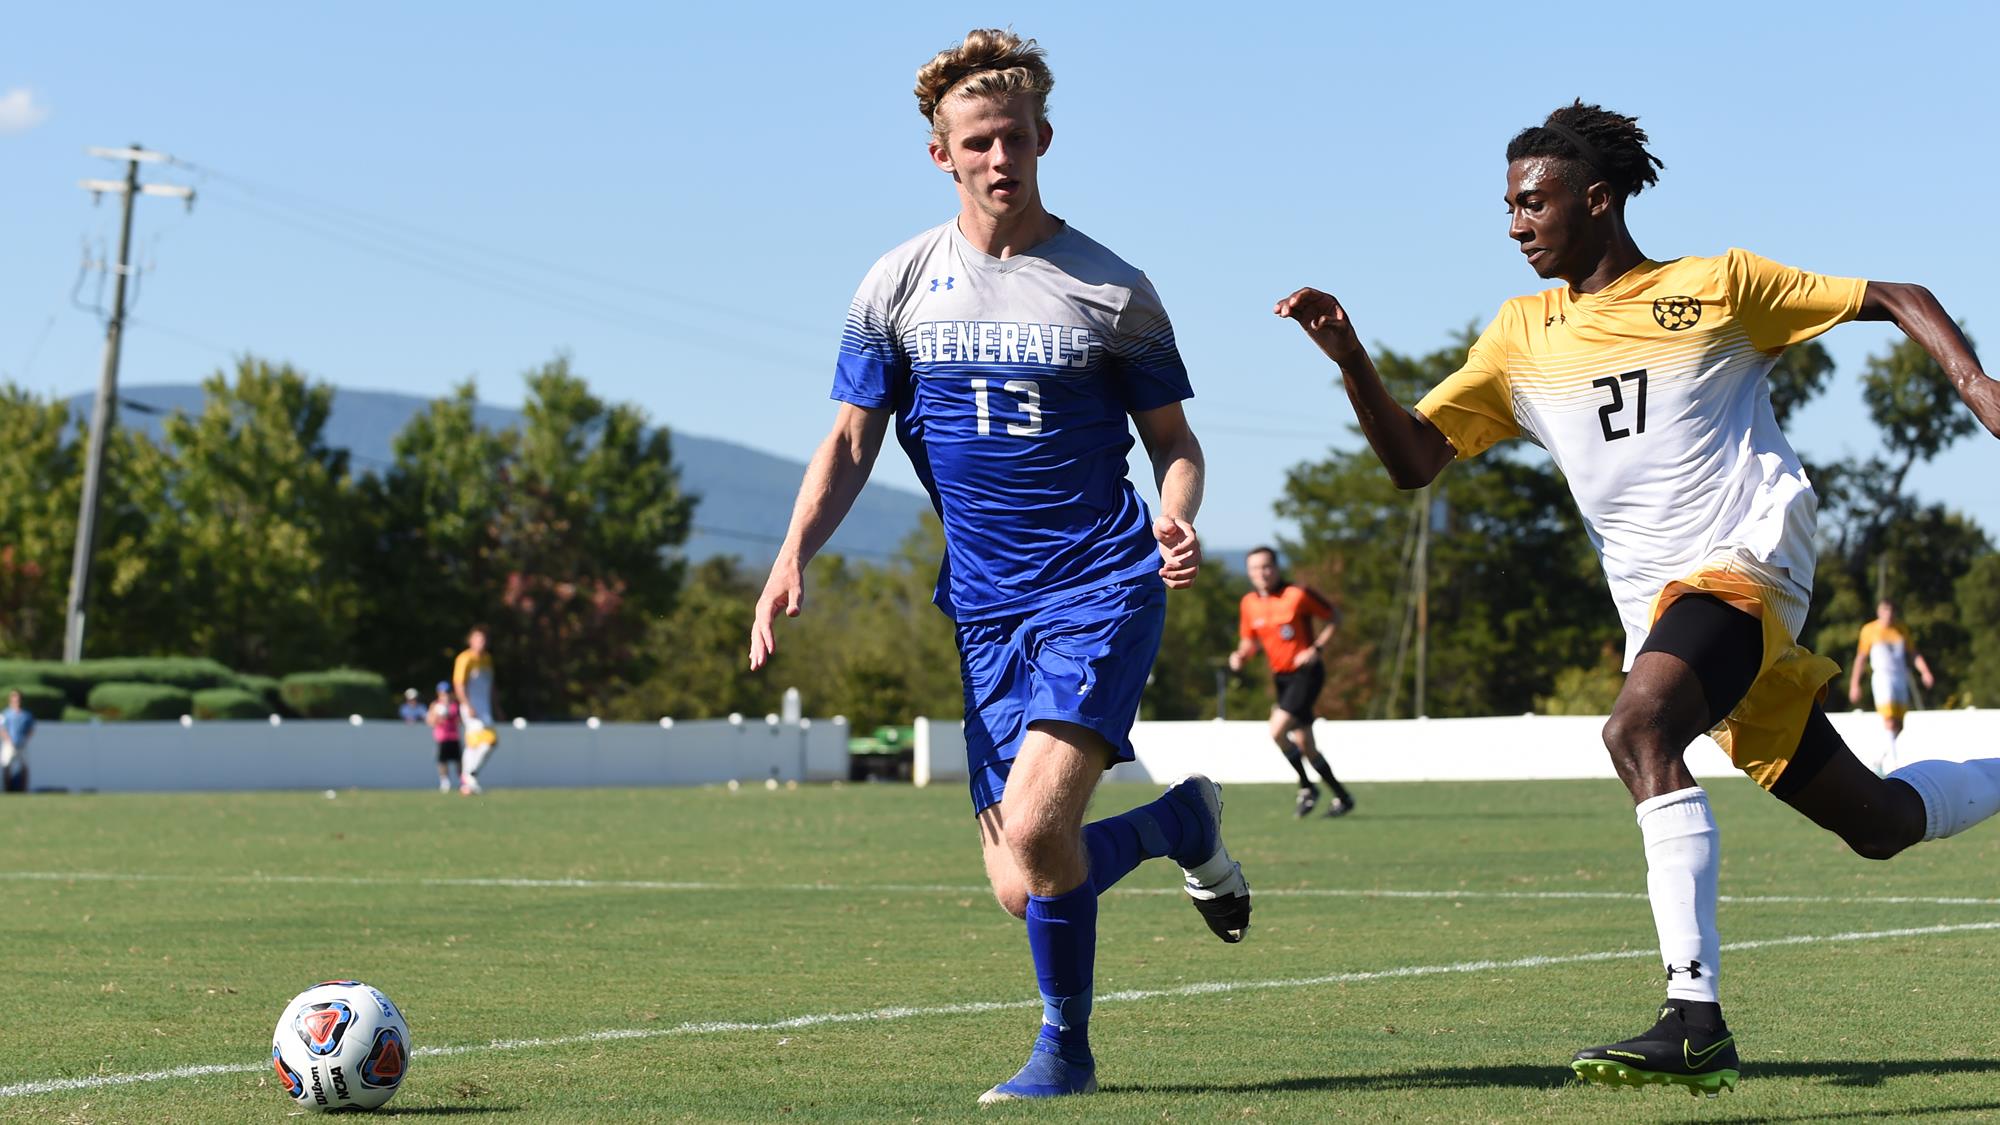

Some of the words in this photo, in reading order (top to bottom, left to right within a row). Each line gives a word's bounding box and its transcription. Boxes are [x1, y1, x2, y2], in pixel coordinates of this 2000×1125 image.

[915, 321, 1090, 368] GENERALS
[971, 379, 1042, 436] 13
[1592, 369, 1648, 442] 27
[311, 1066, 328, 1105] Wilson
[330, 1066, 350, 1099] NCAA
